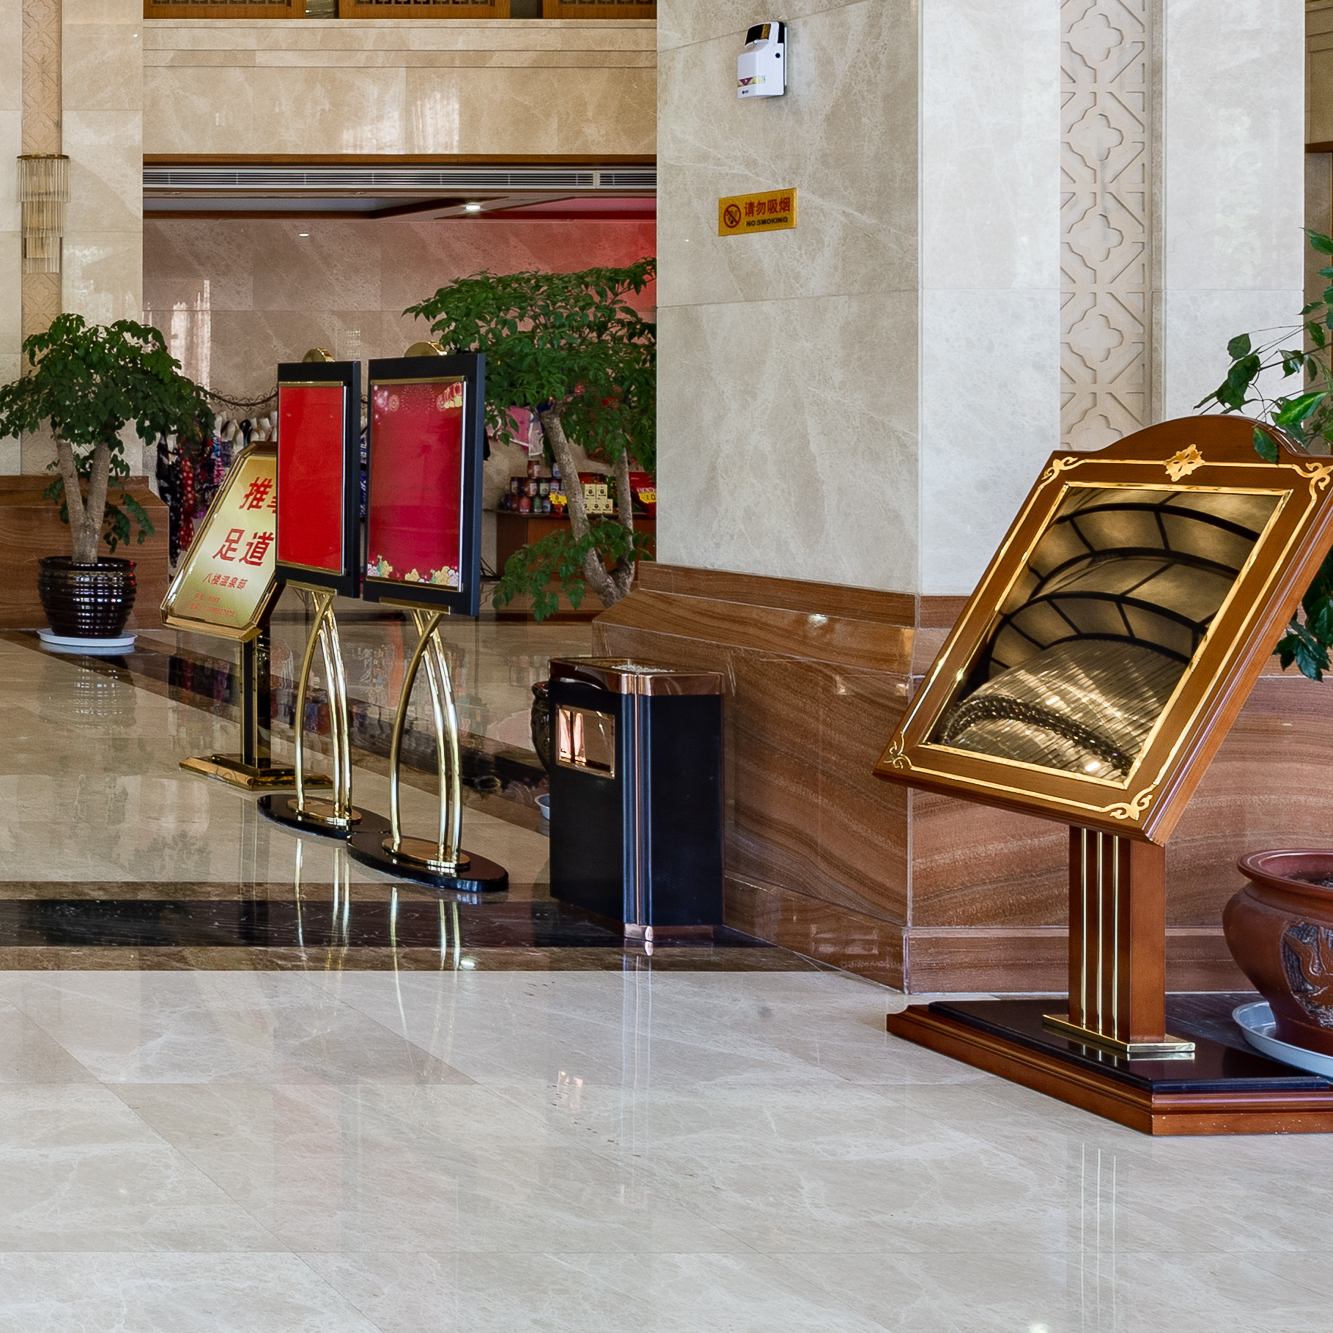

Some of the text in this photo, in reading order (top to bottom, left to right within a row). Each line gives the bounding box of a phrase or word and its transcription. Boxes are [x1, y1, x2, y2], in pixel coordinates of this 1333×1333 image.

[744, 197, 791, 217] 请勿吸烟
[757, 216, 788, 226] SMOKING
[212, 528, 275, 567] 足道
